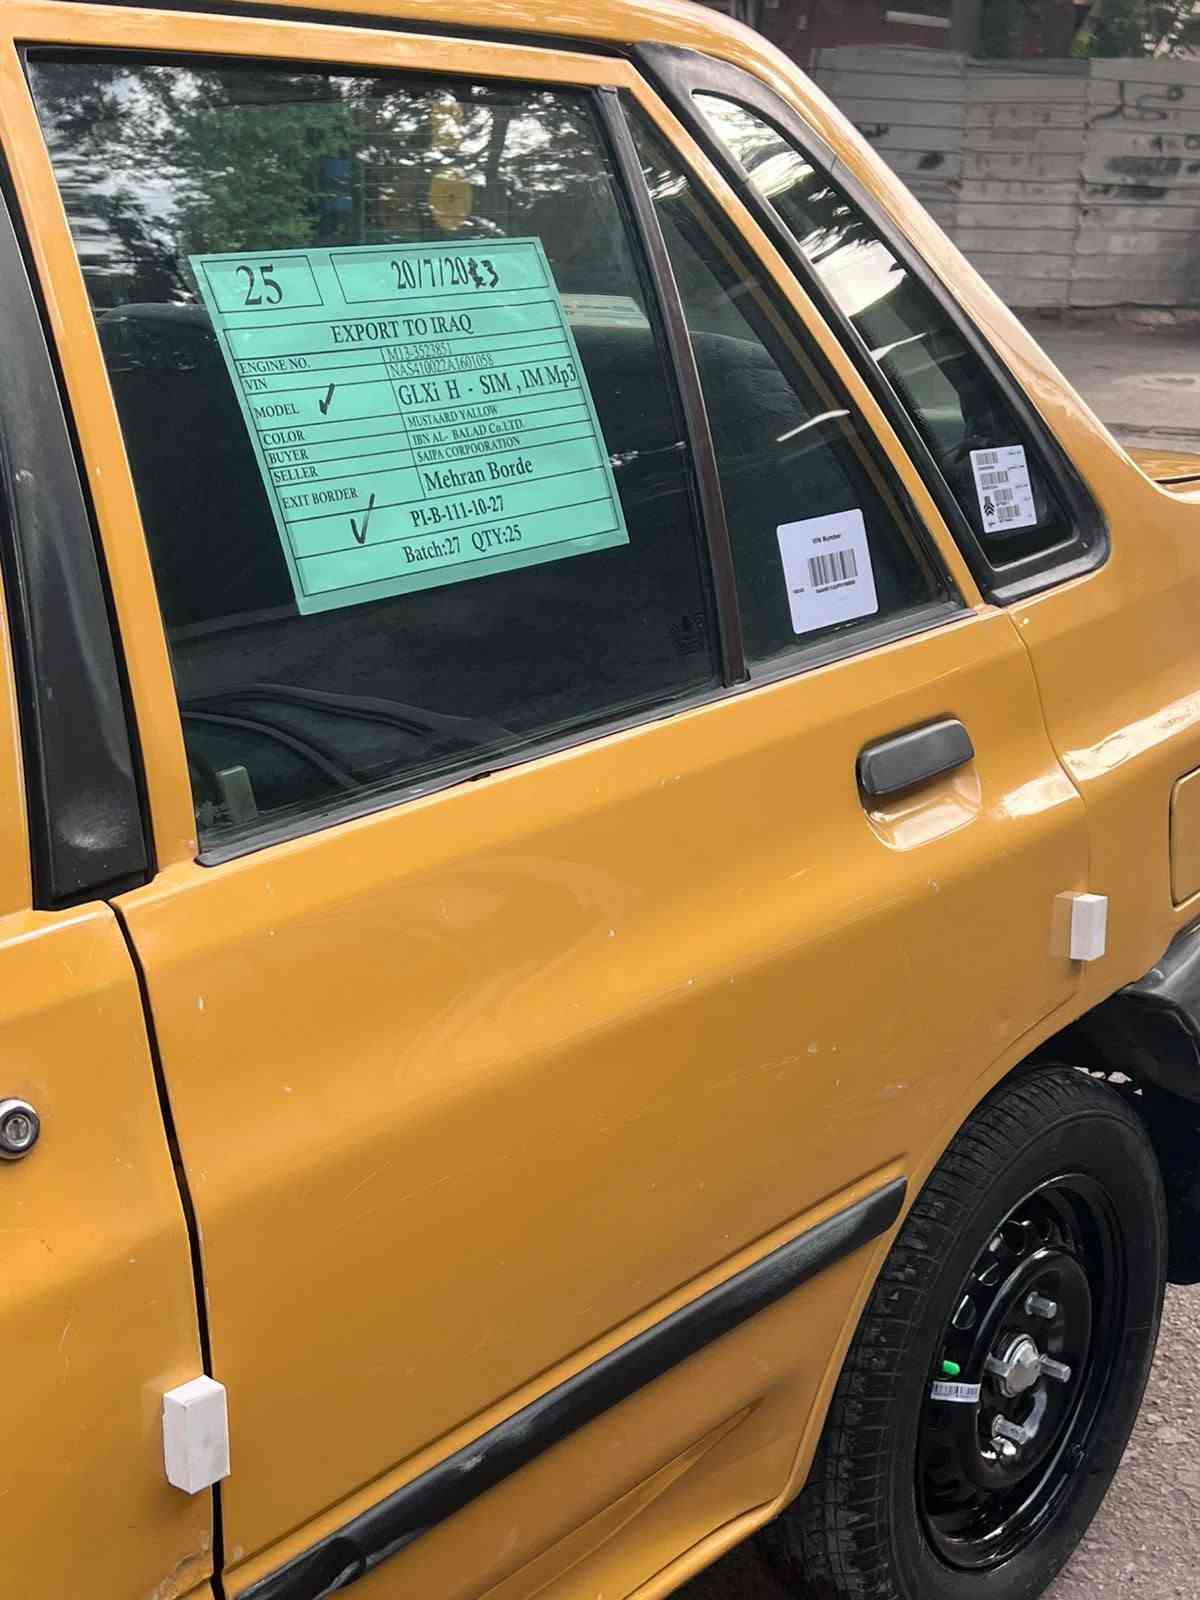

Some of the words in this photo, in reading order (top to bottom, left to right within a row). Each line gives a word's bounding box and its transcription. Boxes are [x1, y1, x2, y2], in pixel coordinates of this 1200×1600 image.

[236, 264, 283, 305] 25
[331, 318, 399, 343] EXPORT
[403, 316, 427, 337] TO
[430, 313, 474, 336] IRAQ
[240, 360, 288, 374] ENGINE
[244, 378, 269, 391] VIN
[398, 381, 440, 406] GLXi
[444, 378, 461, 400] H
[479, 372, 512, 395] SIM
[544, 363, 576, 388] Mp3
[253, 403, 300, 419] MODEL
[458, 405, 498, 421] YALLOW
[263, 430, 306, 446] COLOR
[412, 432, 430, 446] IBN
[452, 424, 487, 440] BALAD
[268, 448, 309, 464] BUYER
[417, 447, 445, 463] SAIPA
[273, 465, 318, 483] SELLER
[423, 469, 486, 492] Mehran
[487, 456, 534, 481] Borde
[282, 494, 313, 510] EXIT
[312, 487, 359, 505] BORDER
[409, 495, 504, 528] PI-B-111-10-27
[402, 536, 461, 564] Batch:27
[471, 524, 522, 553] QTY:25
